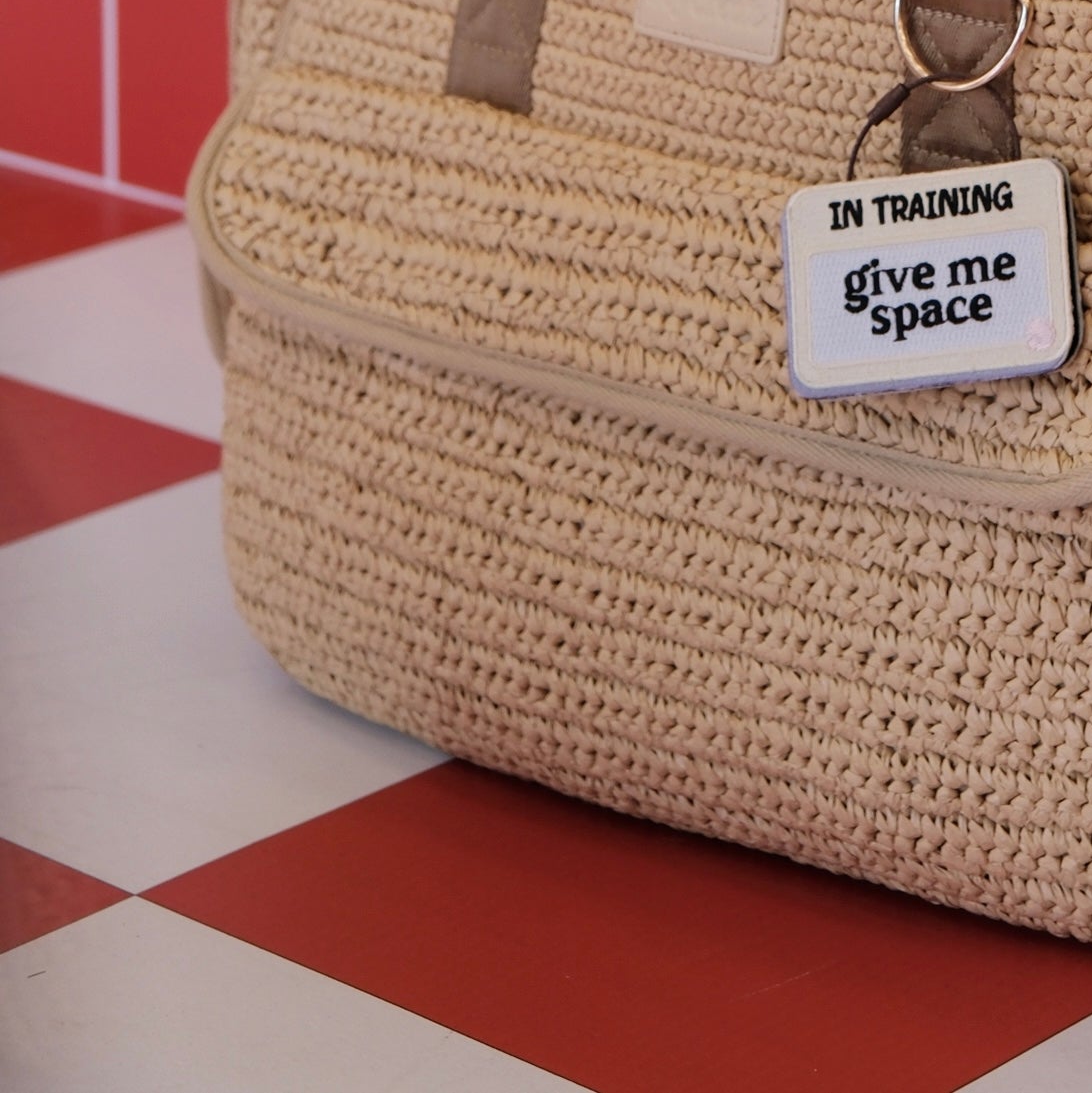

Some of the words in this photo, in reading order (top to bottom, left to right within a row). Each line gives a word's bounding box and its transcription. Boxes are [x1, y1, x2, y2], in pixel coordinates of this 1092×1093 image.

[828, 198, 863, 231] IN
[871, 181, 1014, 225] TRAINING
[844, 258, 936, 314] give
[946, 252, 1017, 288] me
[870, 293, 993, 342] space
